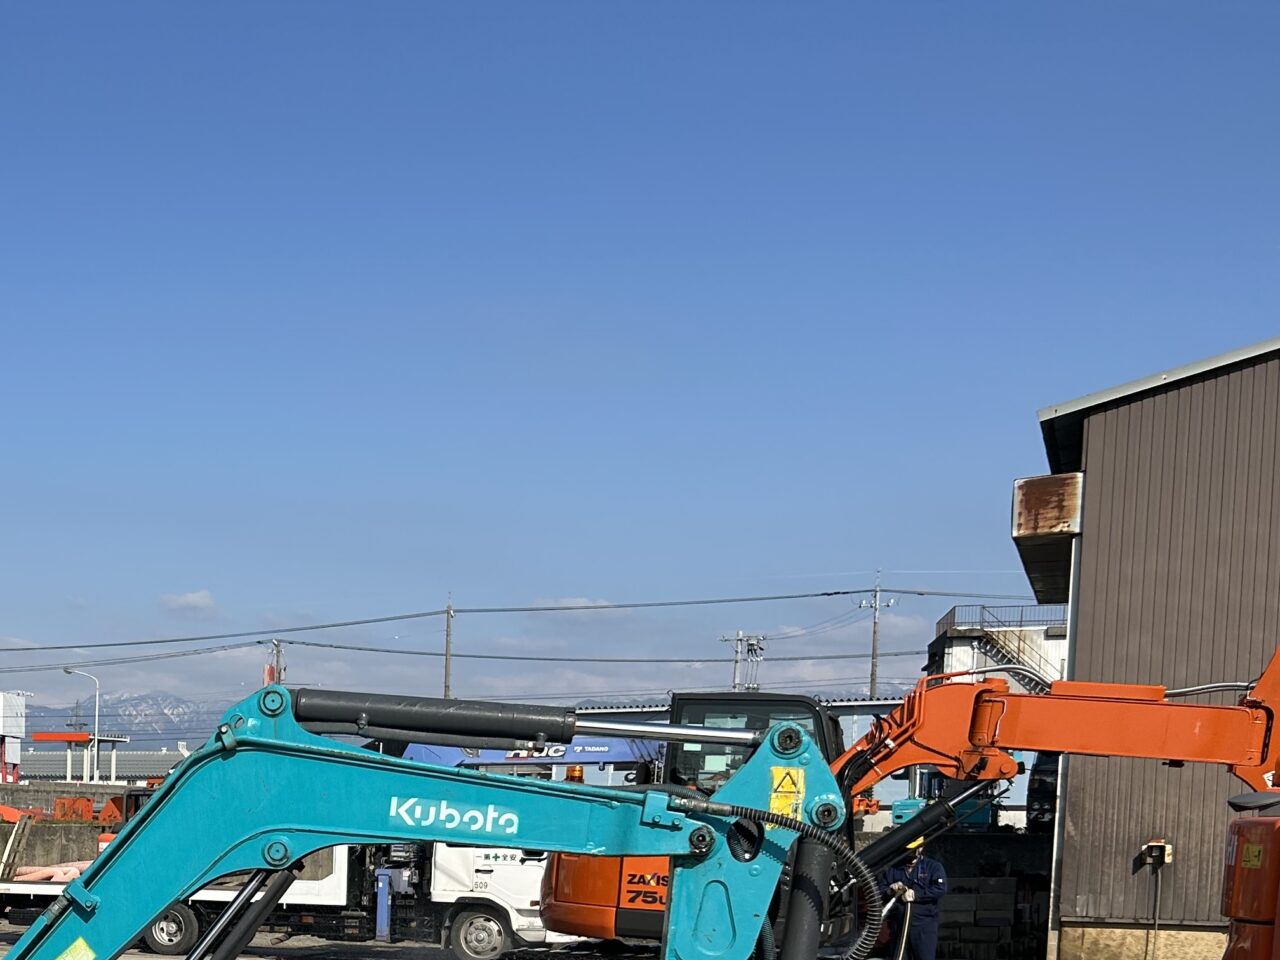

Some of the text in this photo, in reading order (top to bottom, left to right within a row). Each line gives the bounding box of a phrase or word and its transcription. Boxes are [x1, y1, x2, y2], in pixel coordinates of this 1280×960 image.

[389, 796, 520, 835] Kubota
[474, 881, 489, 890] 509
[627, 873, 670, 887] ZAXIS
